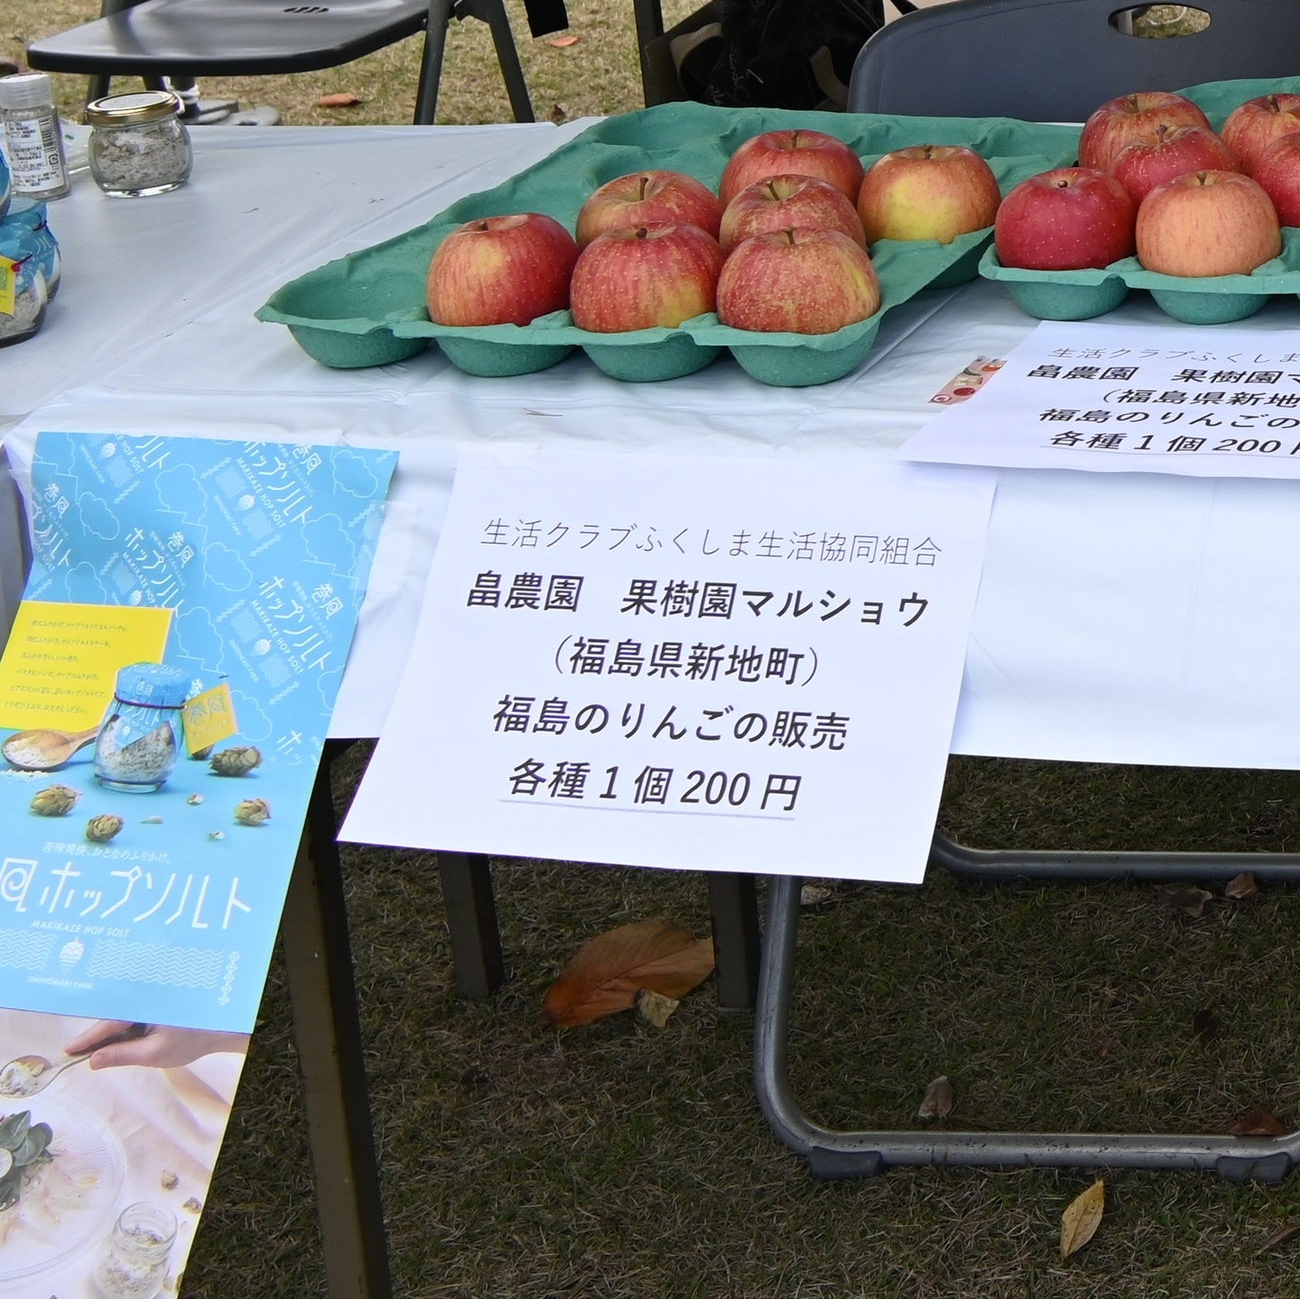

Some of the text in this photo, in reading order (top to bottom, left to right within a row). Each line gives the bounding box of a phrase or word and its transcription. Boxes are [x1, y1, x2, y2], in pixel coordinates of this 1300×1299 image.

[1027, 364, 1139, 384] 畠農園
[480, 517, 944, 568] 生活クラブふくしま生活協同組合
[259, 576, 332, 670] ホップソルト
[467, 569, 931, 628] 畠農園 果樹園マルショウ
[553, 634, 820, 688] （福島県新地町）
[492, 694, 851, 752] 福島のりんごの販売
[31, 919, 82, 934] MAKIKAZE
[84, 925, 105, 936] HOP
